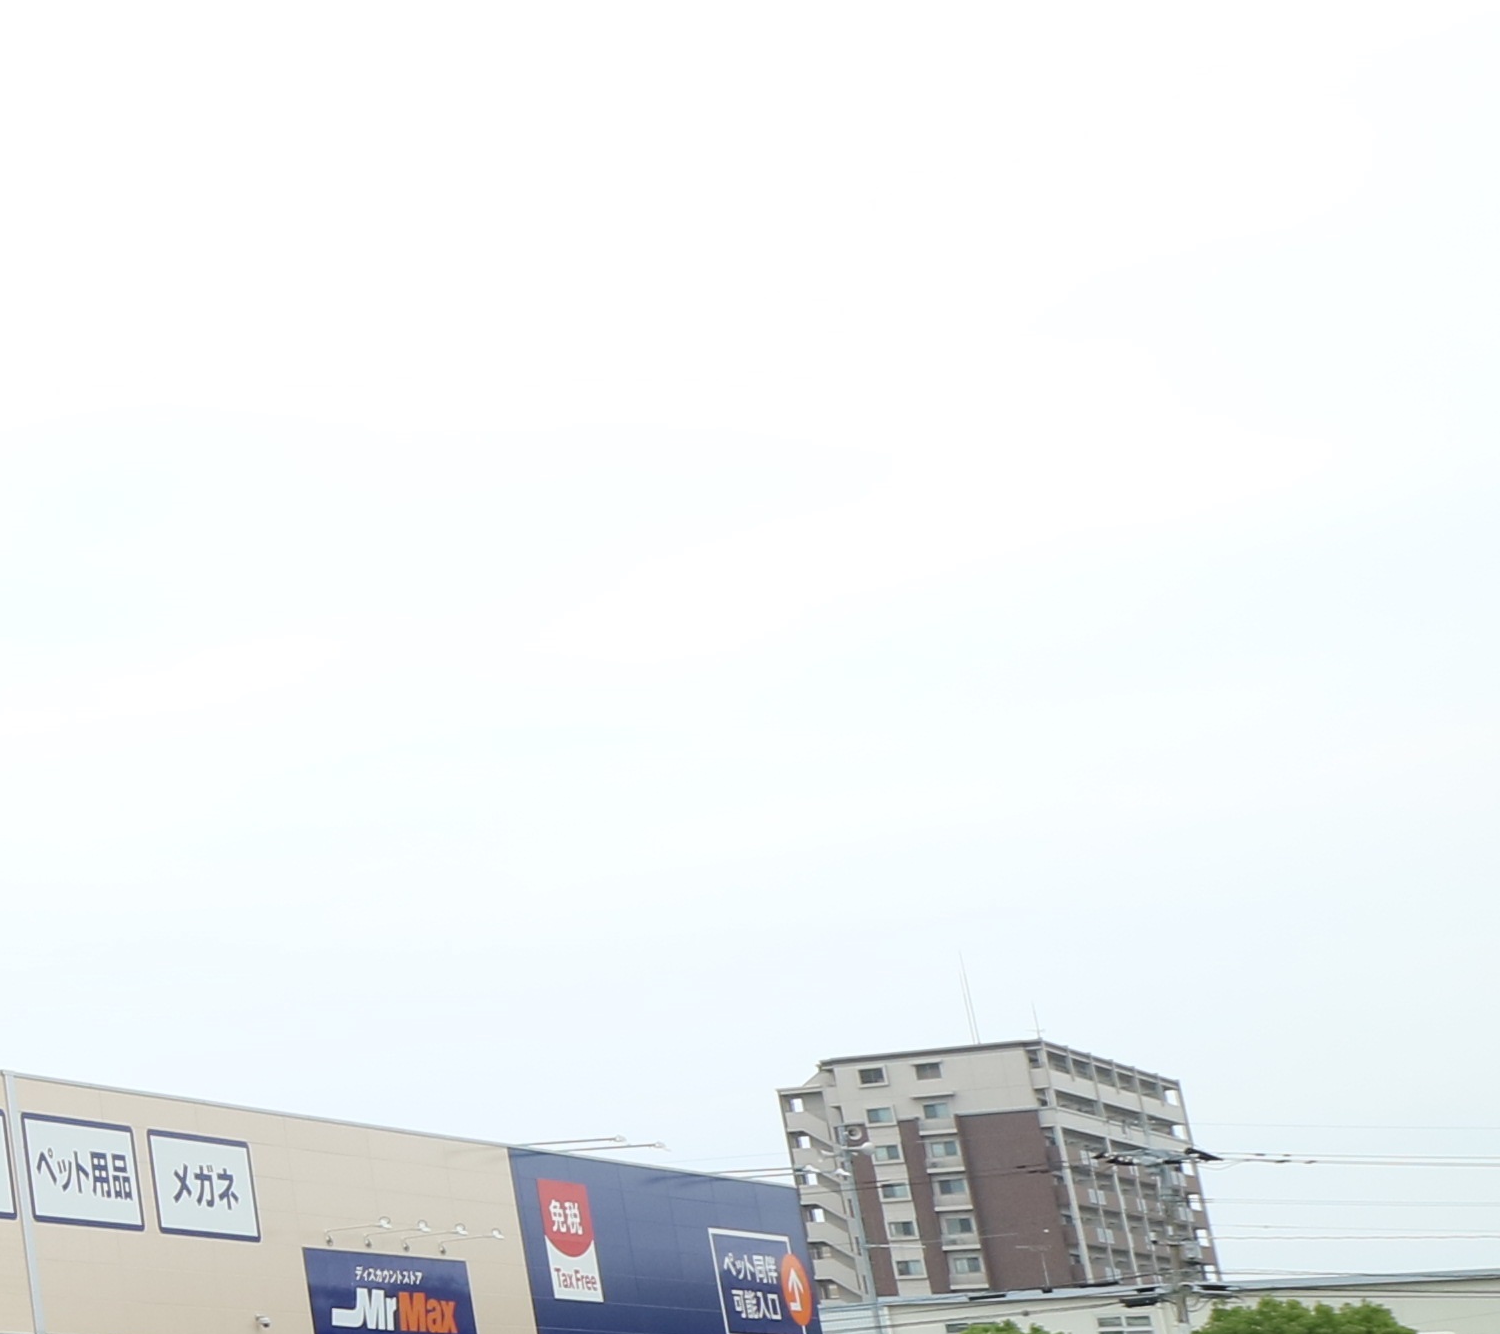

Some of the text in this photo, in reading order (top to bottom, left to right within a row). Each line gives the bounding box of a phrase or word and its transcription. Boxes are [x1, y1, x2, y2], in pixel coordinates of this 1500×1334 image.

[36, 1146, 135, 1202] ペット用品
[172, 1162, 241, 1212] メガネ
[549, 1198, 583, 1235] 免税
[355, 1266, 422, 1285] ディスカウントストア
[554, 1267, 598, 1292] Tax Free
[723, 1252, 778, 1285] ペット同伴
[331, 1287, 458, 1334] MrMax
[731, 1289, 782, 1321] 可能入口
